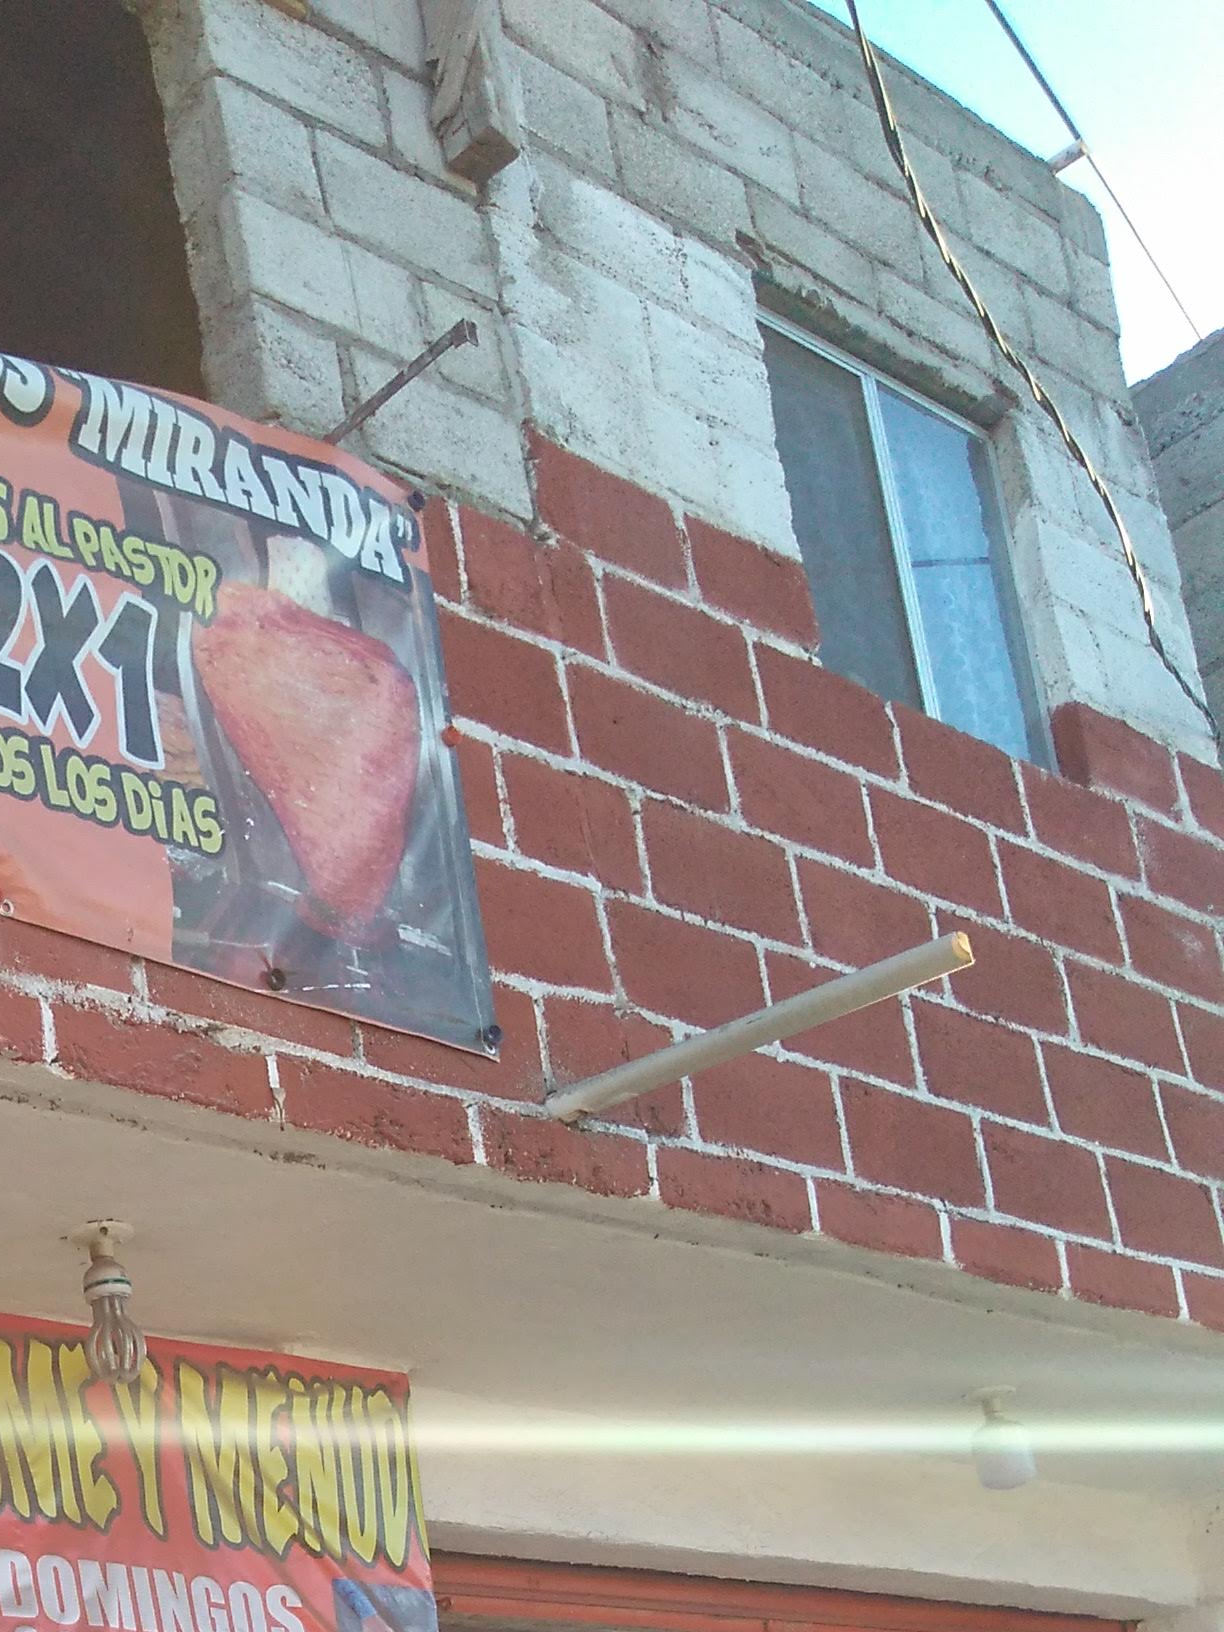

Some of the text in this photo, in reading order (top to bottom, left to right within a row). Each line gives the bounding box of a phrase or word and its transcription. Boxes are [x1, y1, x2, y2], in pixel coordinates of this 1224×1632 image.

[22, 496, 74, 560] AL
[75, 517, 218, 619] PASTOR
[41, 745, 117, 824] LOS
[115, 1357, 165, 1536] Y
[179, 1361, 431, 1568] MENUD
